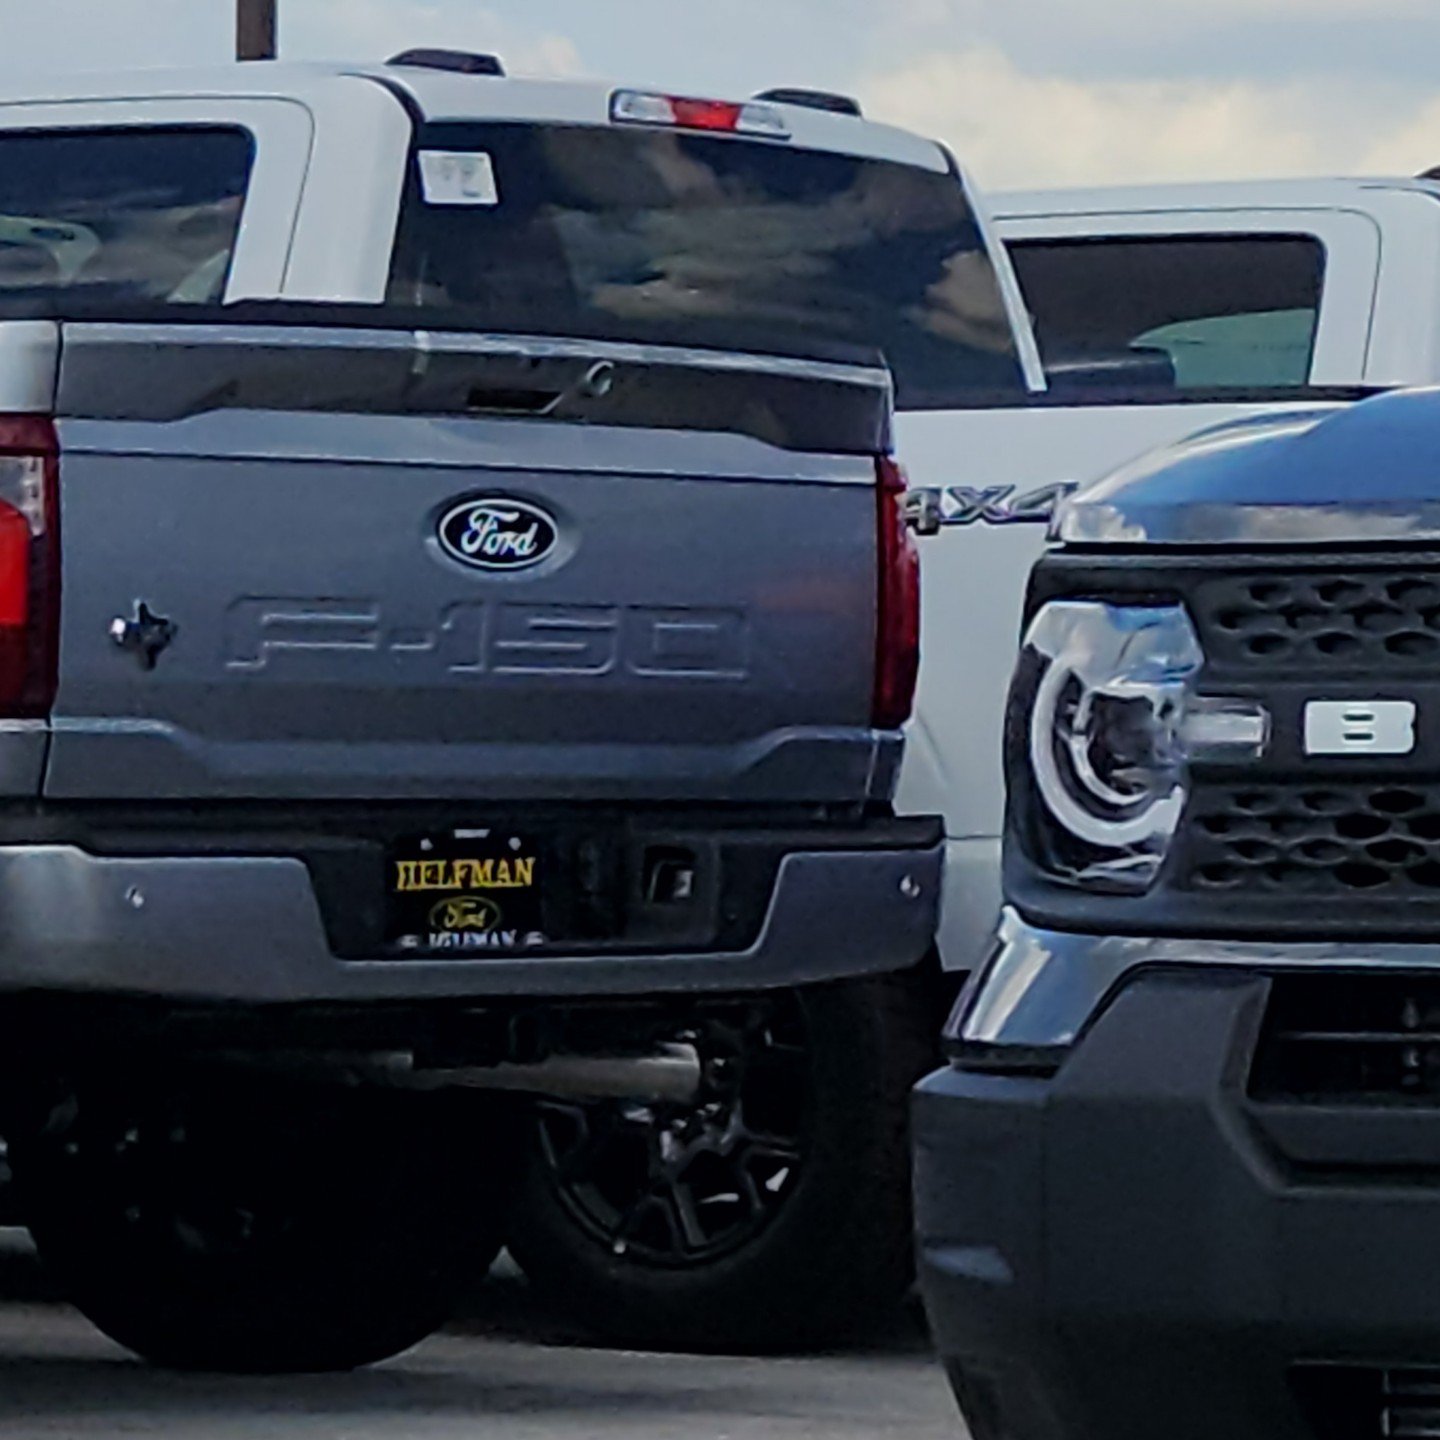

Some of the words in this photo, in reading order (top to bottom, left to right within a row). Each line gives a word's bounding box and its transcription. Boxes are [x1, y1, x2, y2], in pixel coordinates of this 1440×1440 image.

[461, 508, 539, 556] Ford
[226, 595, 749, 679] F-150
[395, 857, 536, 891] HELFMAN
